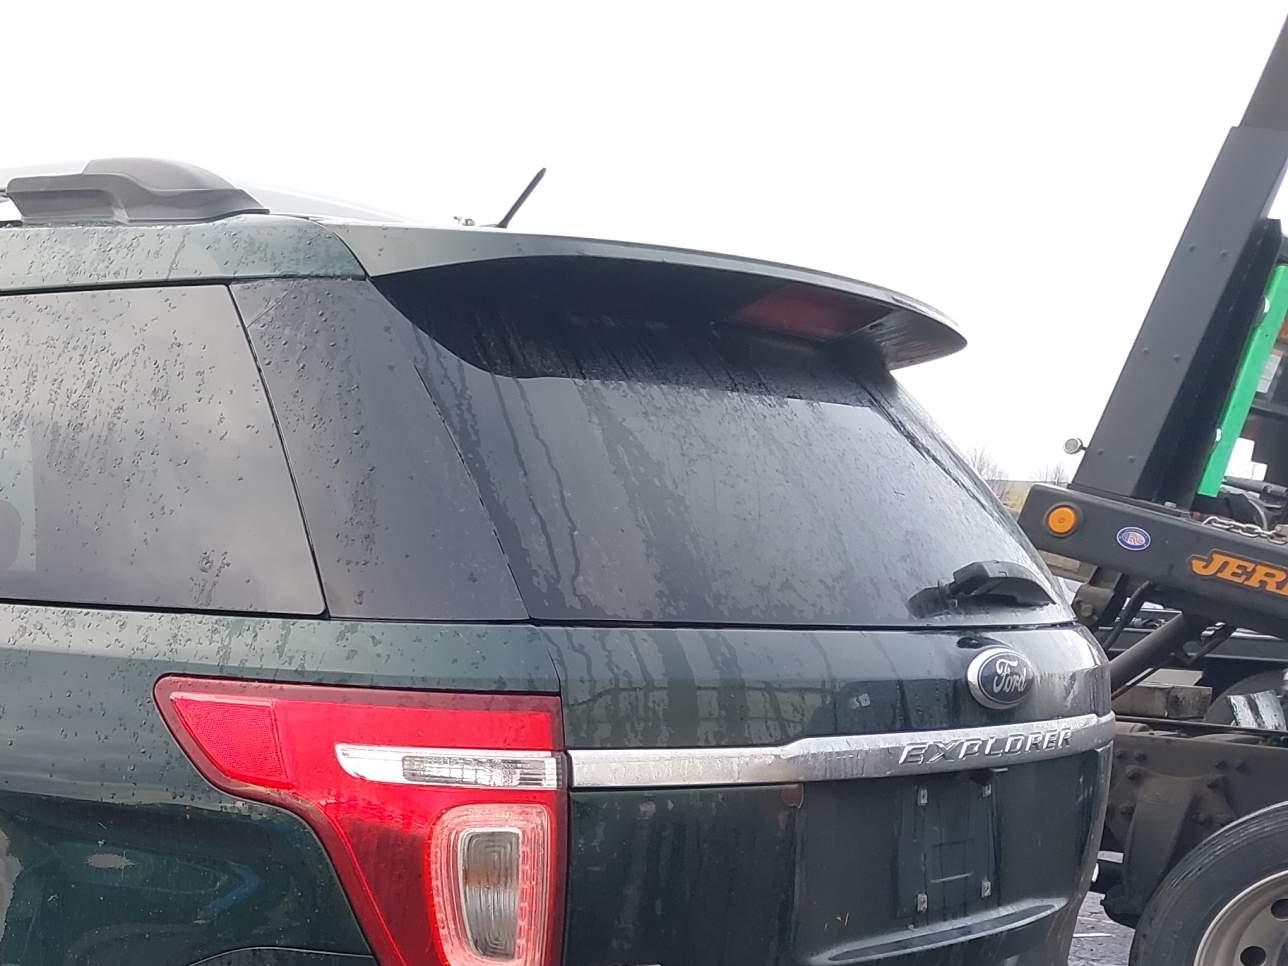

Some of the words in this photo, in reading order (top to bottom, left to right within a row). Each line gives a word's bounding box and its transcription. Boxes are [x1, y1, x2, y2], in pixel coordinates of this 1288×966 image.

[1190, 551, 1288, 597] JER
[992, 658, 1027, 694] Ford
[898, 727, 1072, 766] EXPLORER
